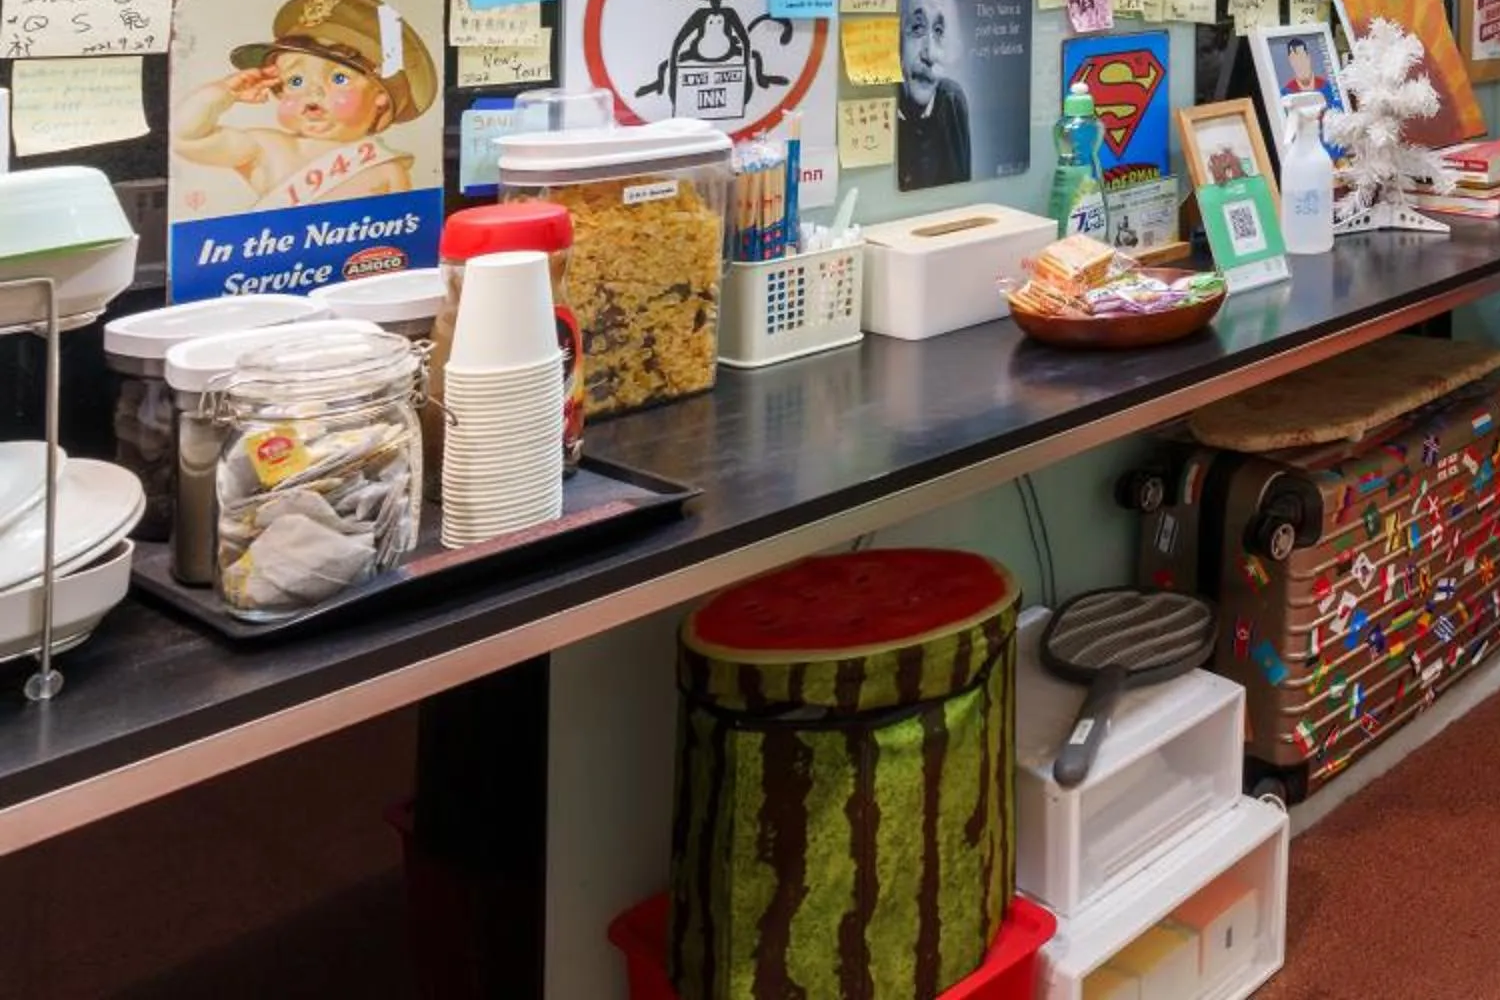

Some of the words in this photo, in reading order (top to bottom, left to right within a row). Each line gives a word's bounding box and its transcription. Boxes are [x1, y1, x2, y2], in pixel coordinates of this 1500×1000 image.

[697, 88, 727, 110] INN
[286, 145, 377, 206] 1942
[199, 238, 233, 266] In
[243, 227, 296, 258] the
[304, 212, 421, 252] Nation's
[223, 258, 333, 296] Service
